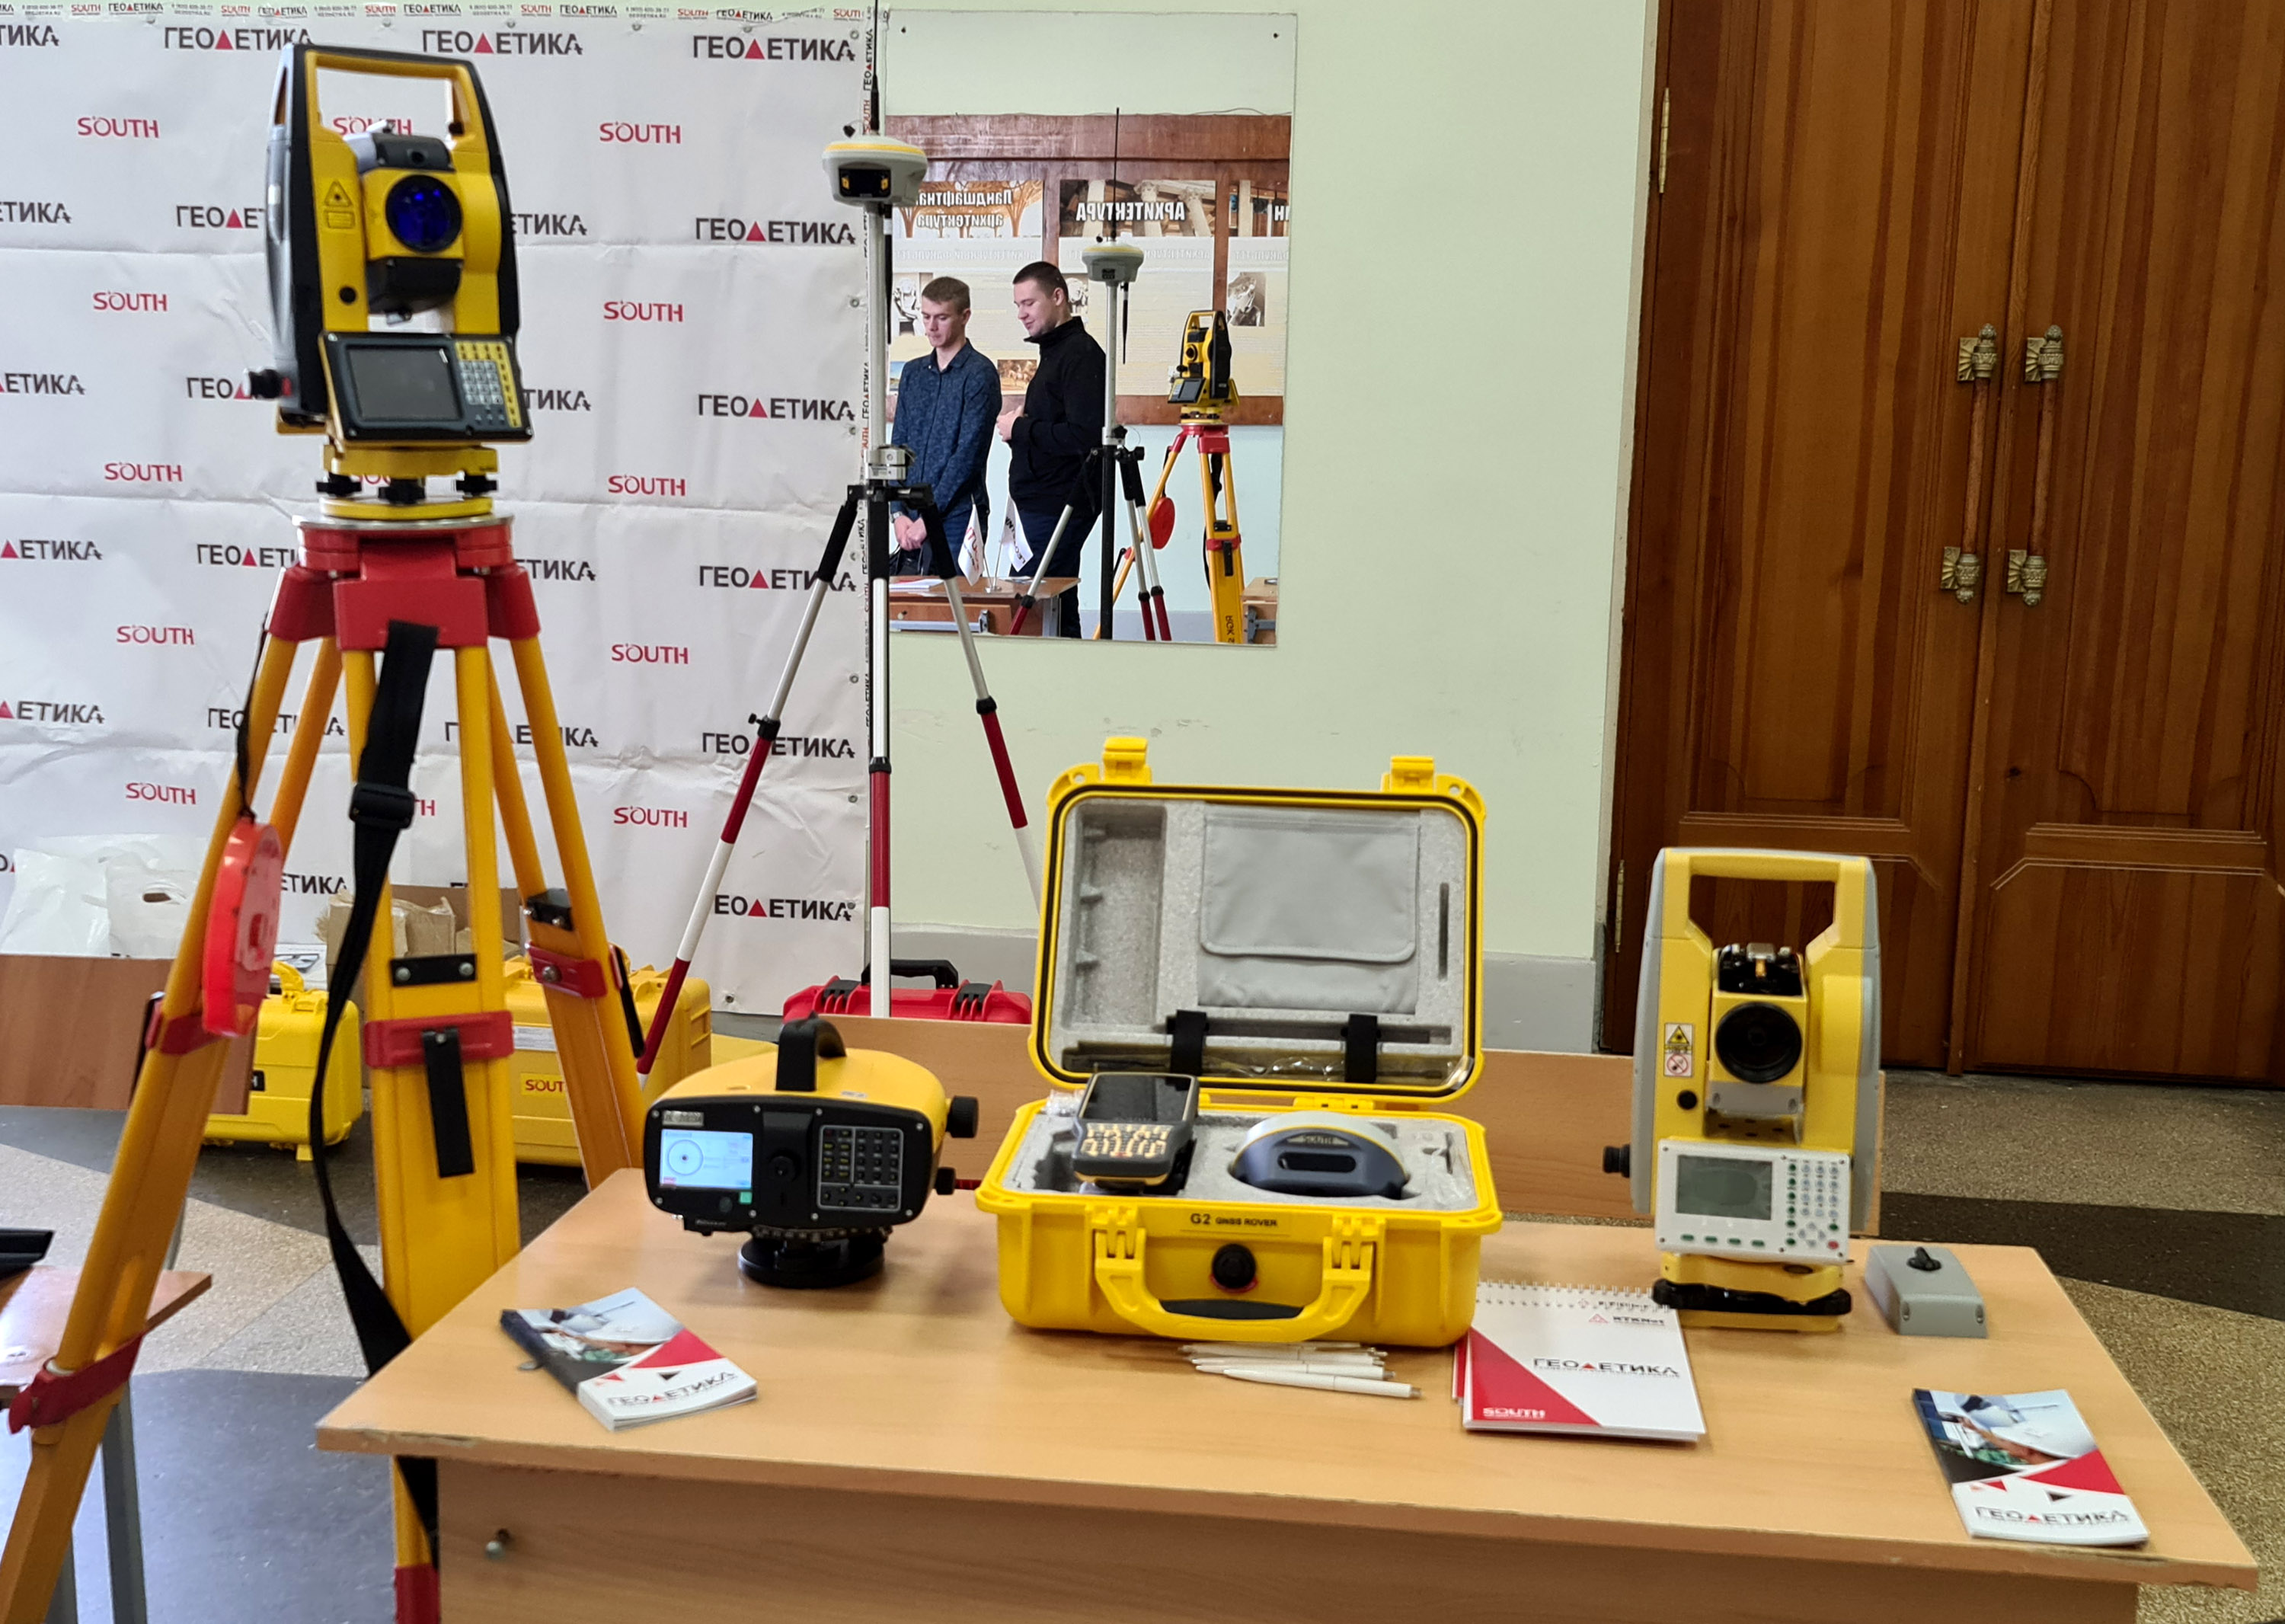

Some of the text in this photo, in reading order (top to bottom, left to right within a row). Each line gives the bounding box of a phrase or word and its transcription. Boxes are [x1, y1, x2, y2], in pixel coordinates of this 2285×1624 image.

[78, 116, 158, 138] SOUTH
[600, 122, 681, 143] SOUTH
[93, 291, 167, 312] SOUTH
[604, 301, 683, 322] SOUTH
[105, 462, 183, 481] SOUTH
[609, 475, 685, 496] SOUTH
[117, 626, 194, 644] SOUTH
[612, 644, 688, 664] SOUTH
[126, 783, 196, 805] SOUTH
[614, 807, 687, 827] SOUTH
[526, 1080, 564, 1092] SOUT
[1190, 1213, 1211, 1225] G2
